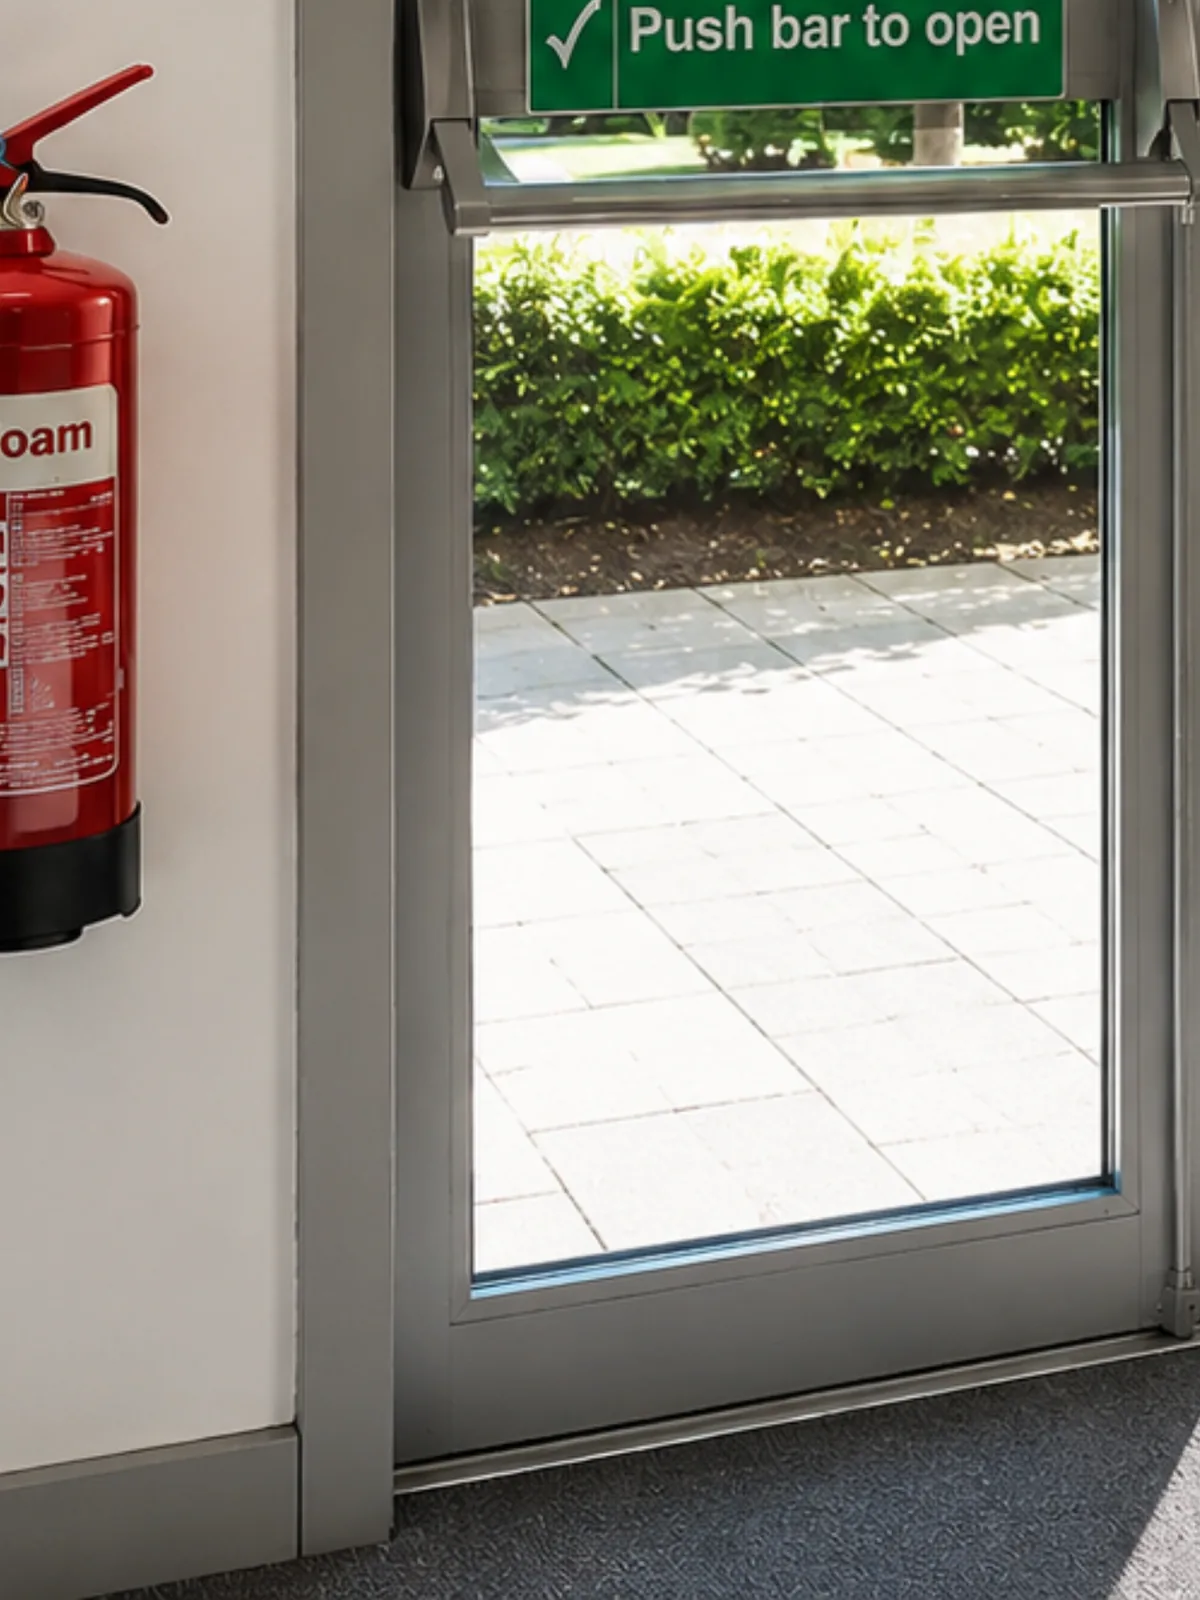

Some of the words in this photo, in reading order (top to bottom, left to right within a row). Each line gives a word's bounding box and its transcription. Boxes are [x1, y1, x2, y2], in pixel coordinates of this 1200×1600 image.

[630, 4, 753, 53] Push
[772, 4, 851, 49] bar
[862, 4, 910, 47] to
[925, 10, 1040, 56] open
